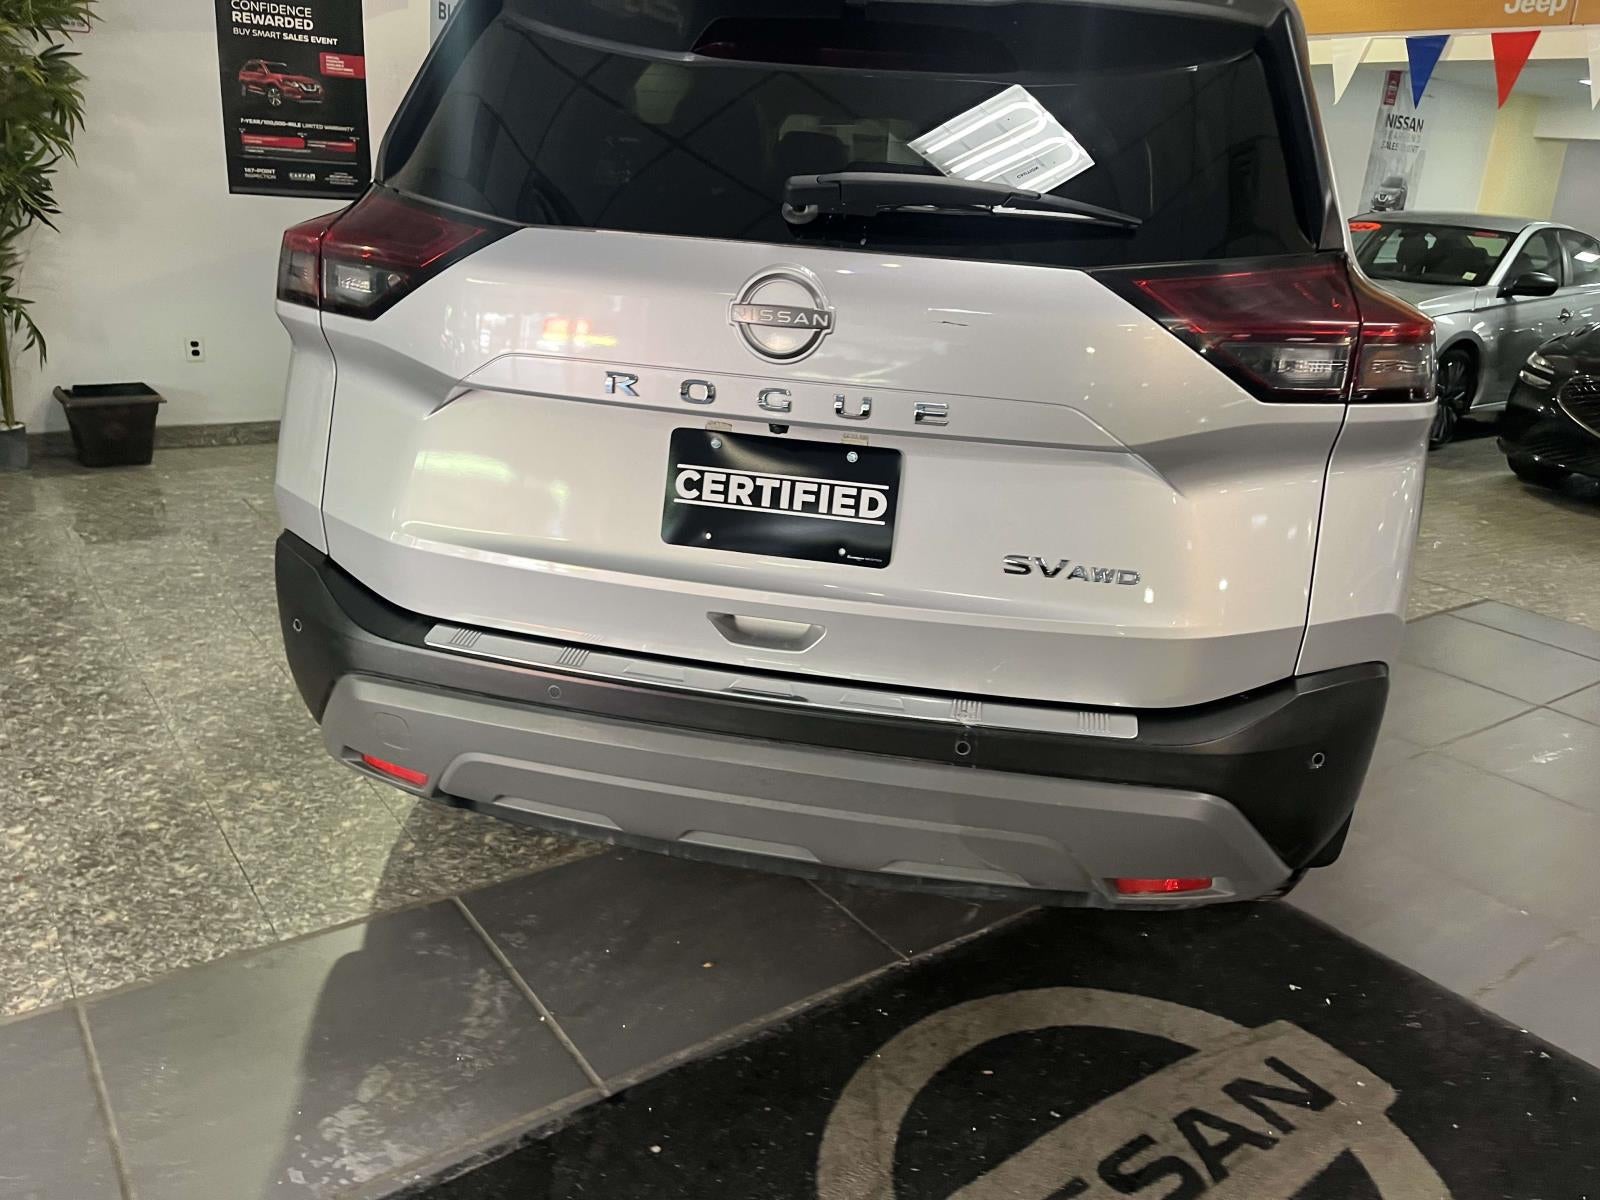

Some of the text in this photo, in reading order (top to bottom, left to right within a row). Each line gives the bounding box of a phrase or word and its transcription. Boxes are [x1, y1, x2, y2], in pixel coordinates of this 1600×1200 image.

[231, 0, 312, 17] CONFIDENCE
[1504, 0, 1568, 16] Jeep
[231, 11, 314, 31] REWARDED
[233, 27, 338, 45] BUY SMART SALES EVENT
[1385, 113, 1425, 132] NISSAN
[734, 307, 829, 327] NISSAN
[604, 370, 949, 427] ROGUE
[675, 469, 888, 519] CERTIFIED
[1042, 1056, 1338, 1200] SAN
